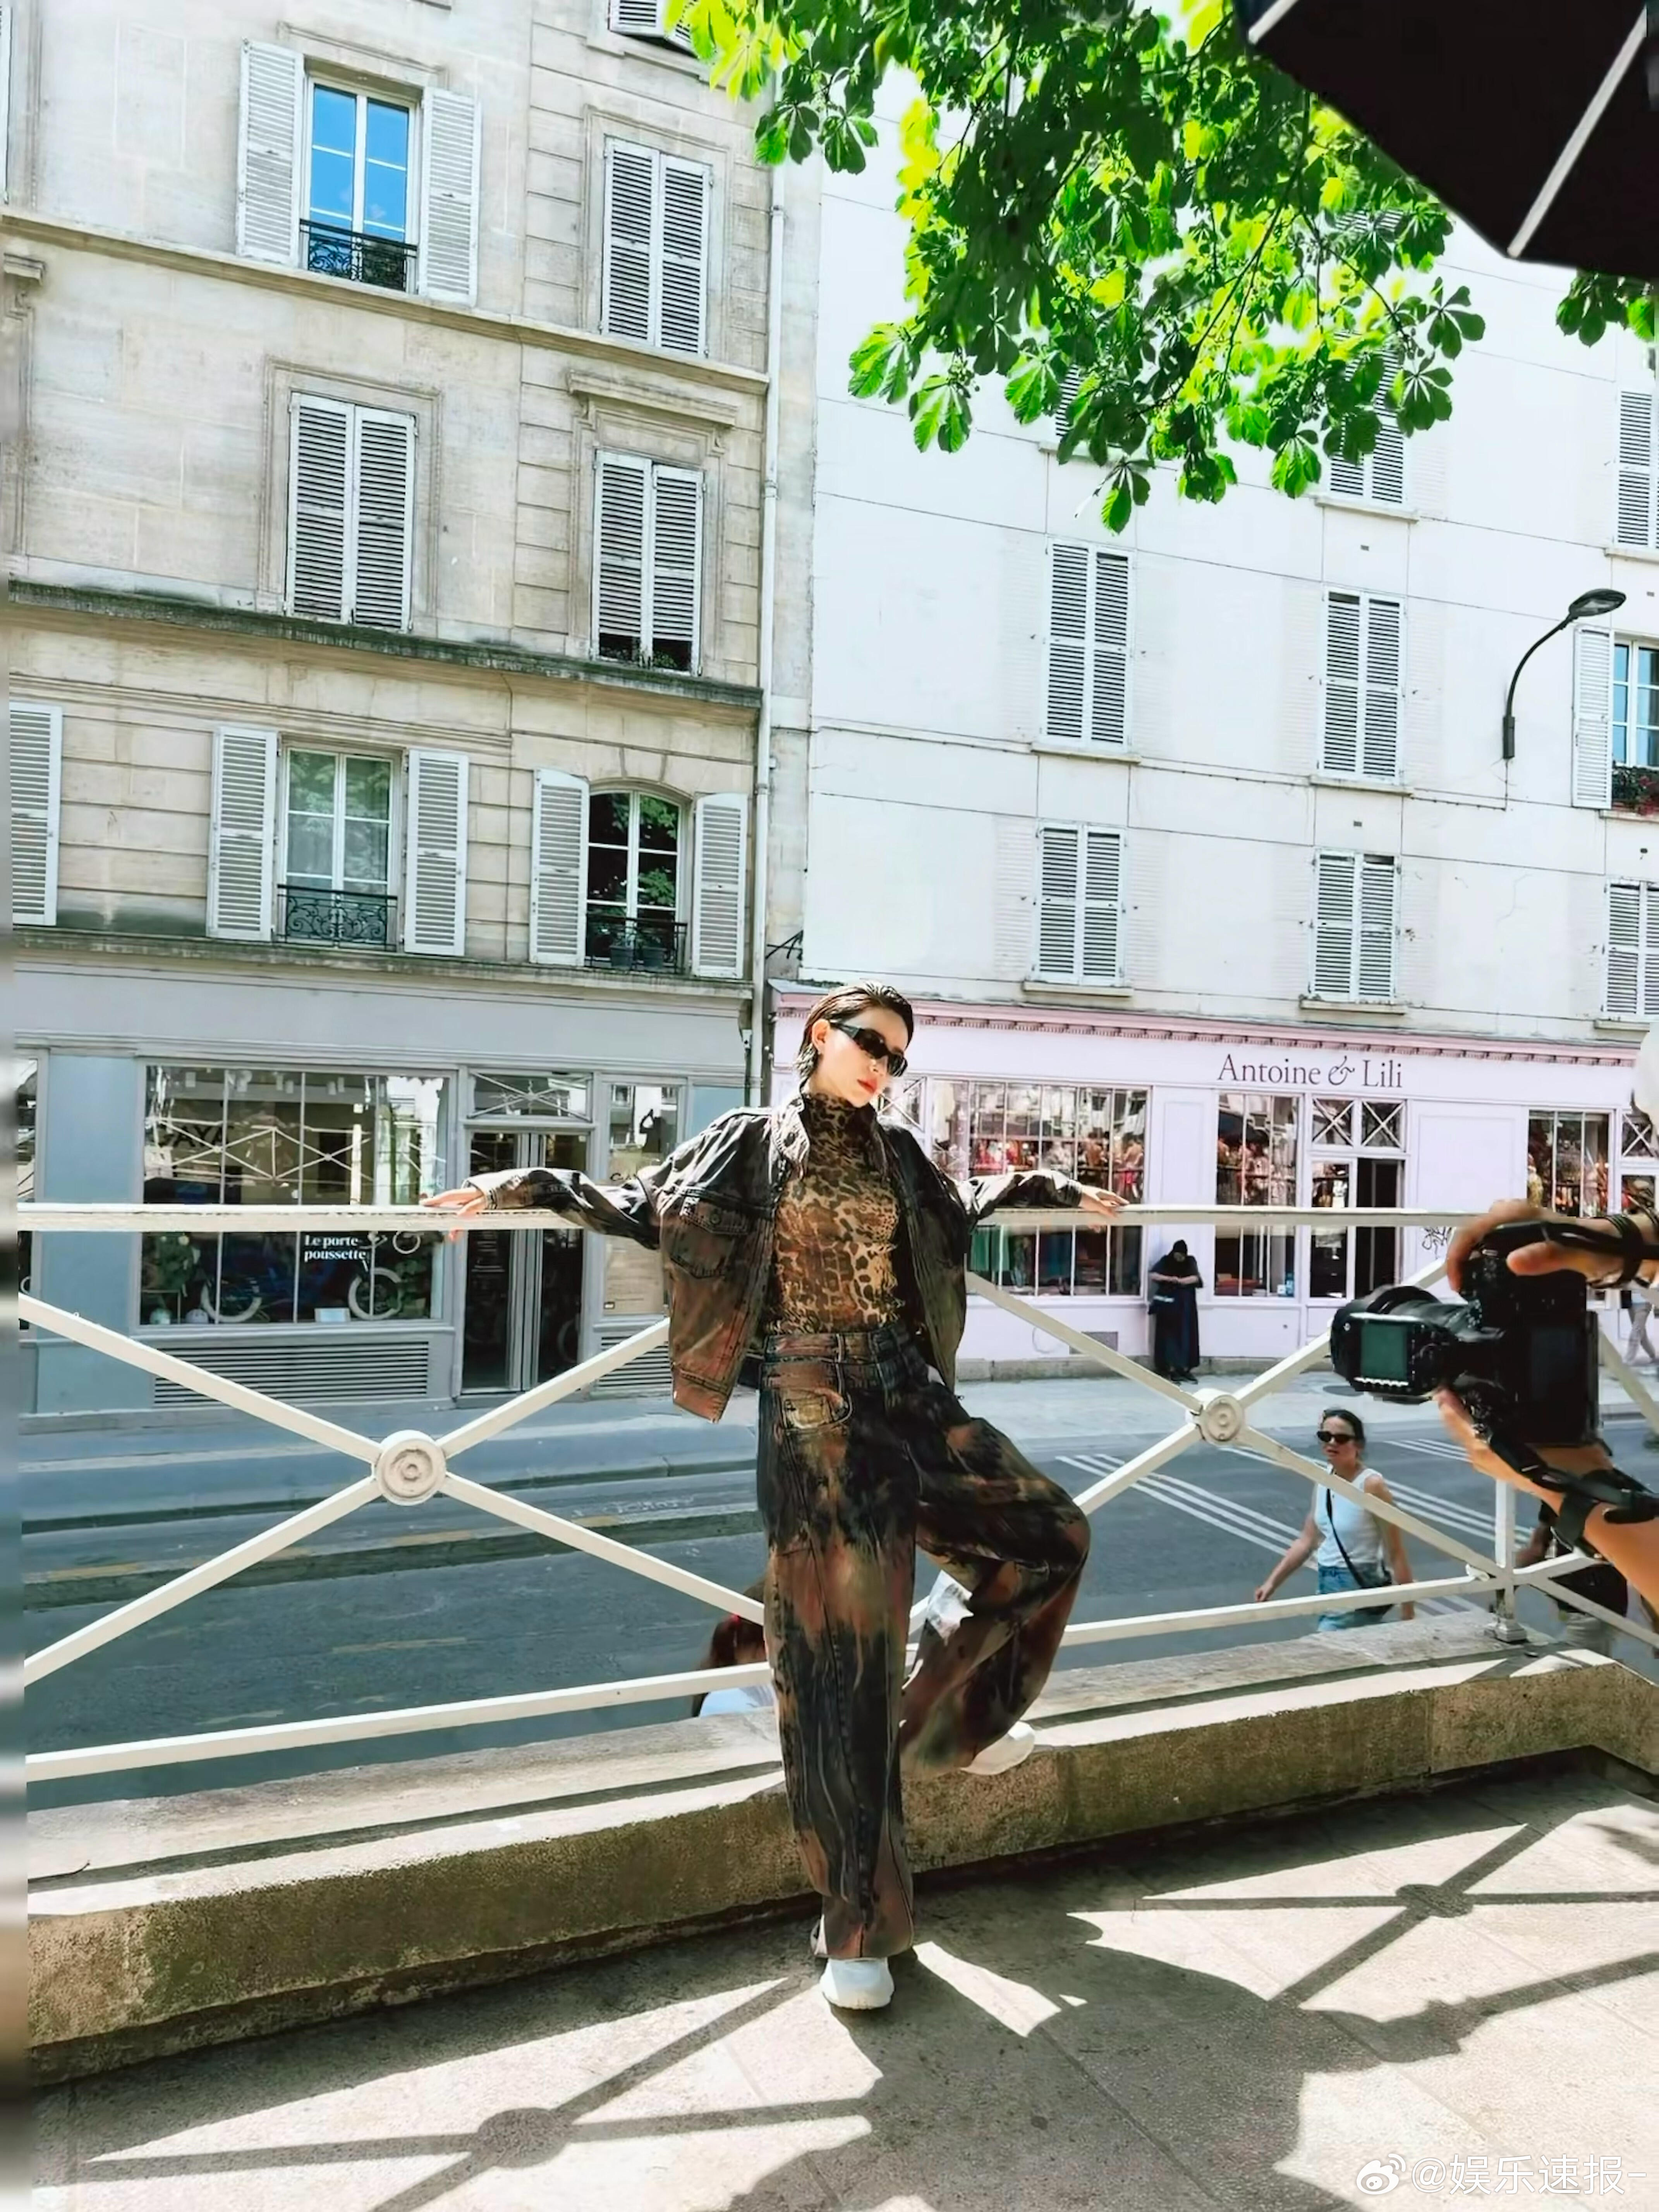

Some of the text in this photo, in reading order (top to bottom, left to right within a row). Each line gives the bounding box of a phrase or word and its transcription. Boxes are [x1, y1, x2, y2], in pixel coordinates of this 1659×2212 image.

[1217, 1054, 1403, 1088] Antoine & Lili
[304, 1234, 321, 1246] Le
[304, 1249, 366, 1262] poussette
